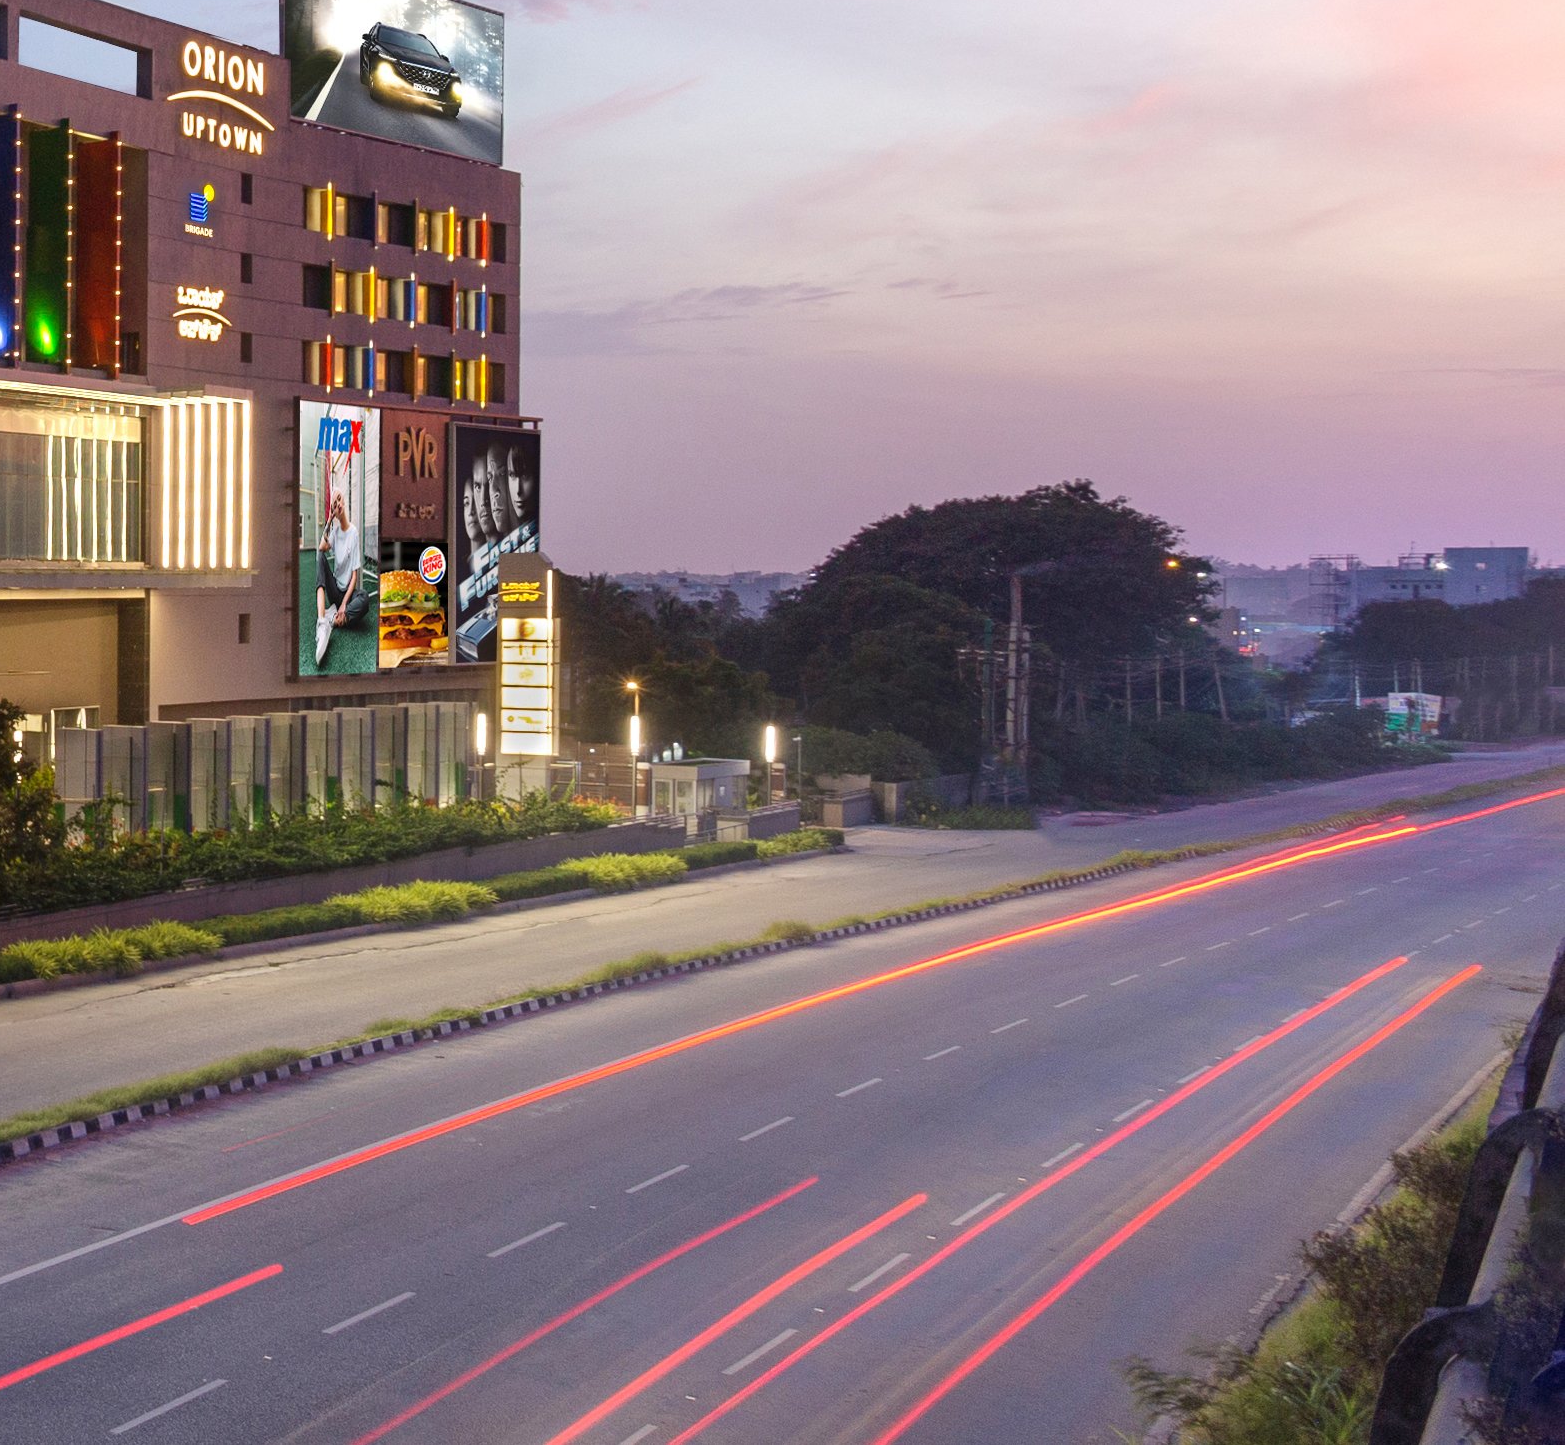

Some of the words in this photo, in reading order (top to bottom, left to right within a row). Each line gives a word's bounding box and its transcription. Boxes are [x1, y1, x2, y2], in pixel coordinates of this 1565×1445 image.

[183, 40, 264, 96] ORION
[182, 111, 263, 155] UPTOWN
[184, 223, 214, 238] BRIGADE
[317, 415, 363, 475] max
[398, 426, 438, 483] PVR
[423, 560, 443, 575] KING
[473, 527, 520, 575] FAST
